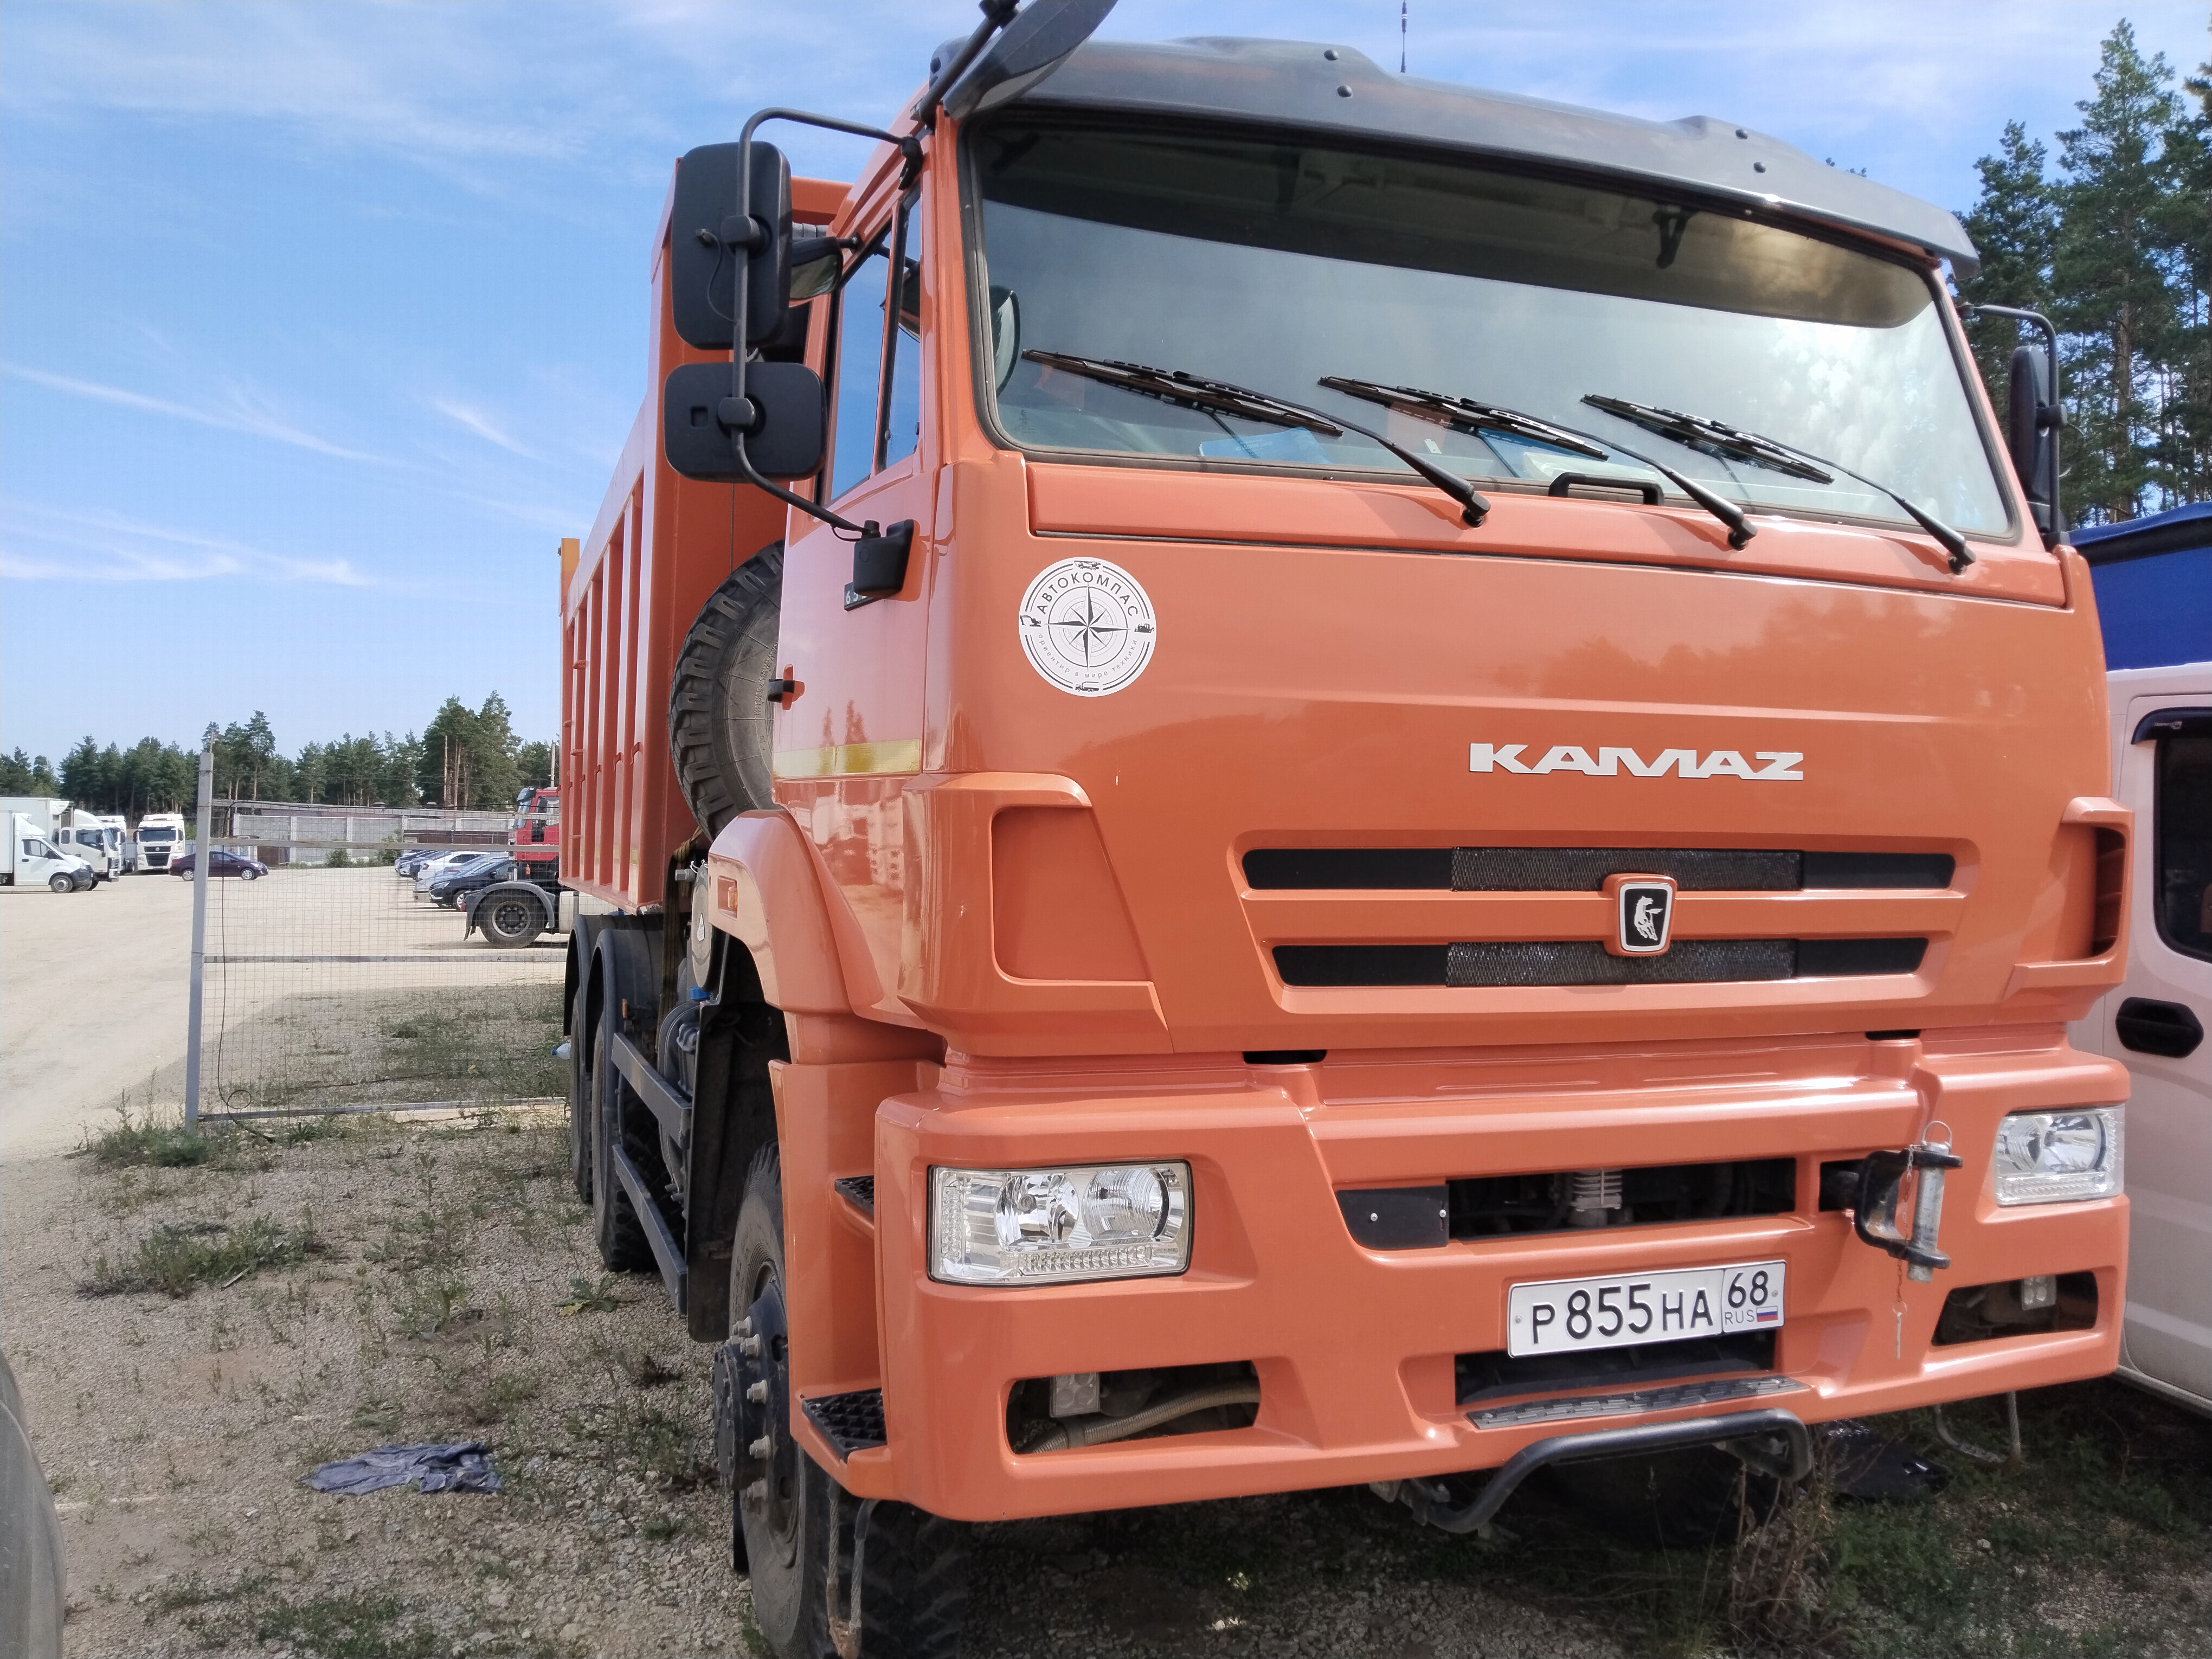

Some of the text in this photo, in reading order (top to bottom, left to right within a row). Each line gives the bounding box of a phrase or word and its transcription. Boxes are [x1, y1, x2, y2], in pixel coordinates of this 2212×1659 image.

[1037, 572, 1138, 617] АВТОКОМПАС
[1038, 634, 1070, 673] ориентир
[1084, 671, 1108, 679] мире
[1111, 640, 1137, 672] техники
[1470, 742, 1804, 781] KAMAZ
[1727, 1270, 1769, 1309] 68
[1725, 1309, 1755, 1326] RUS
